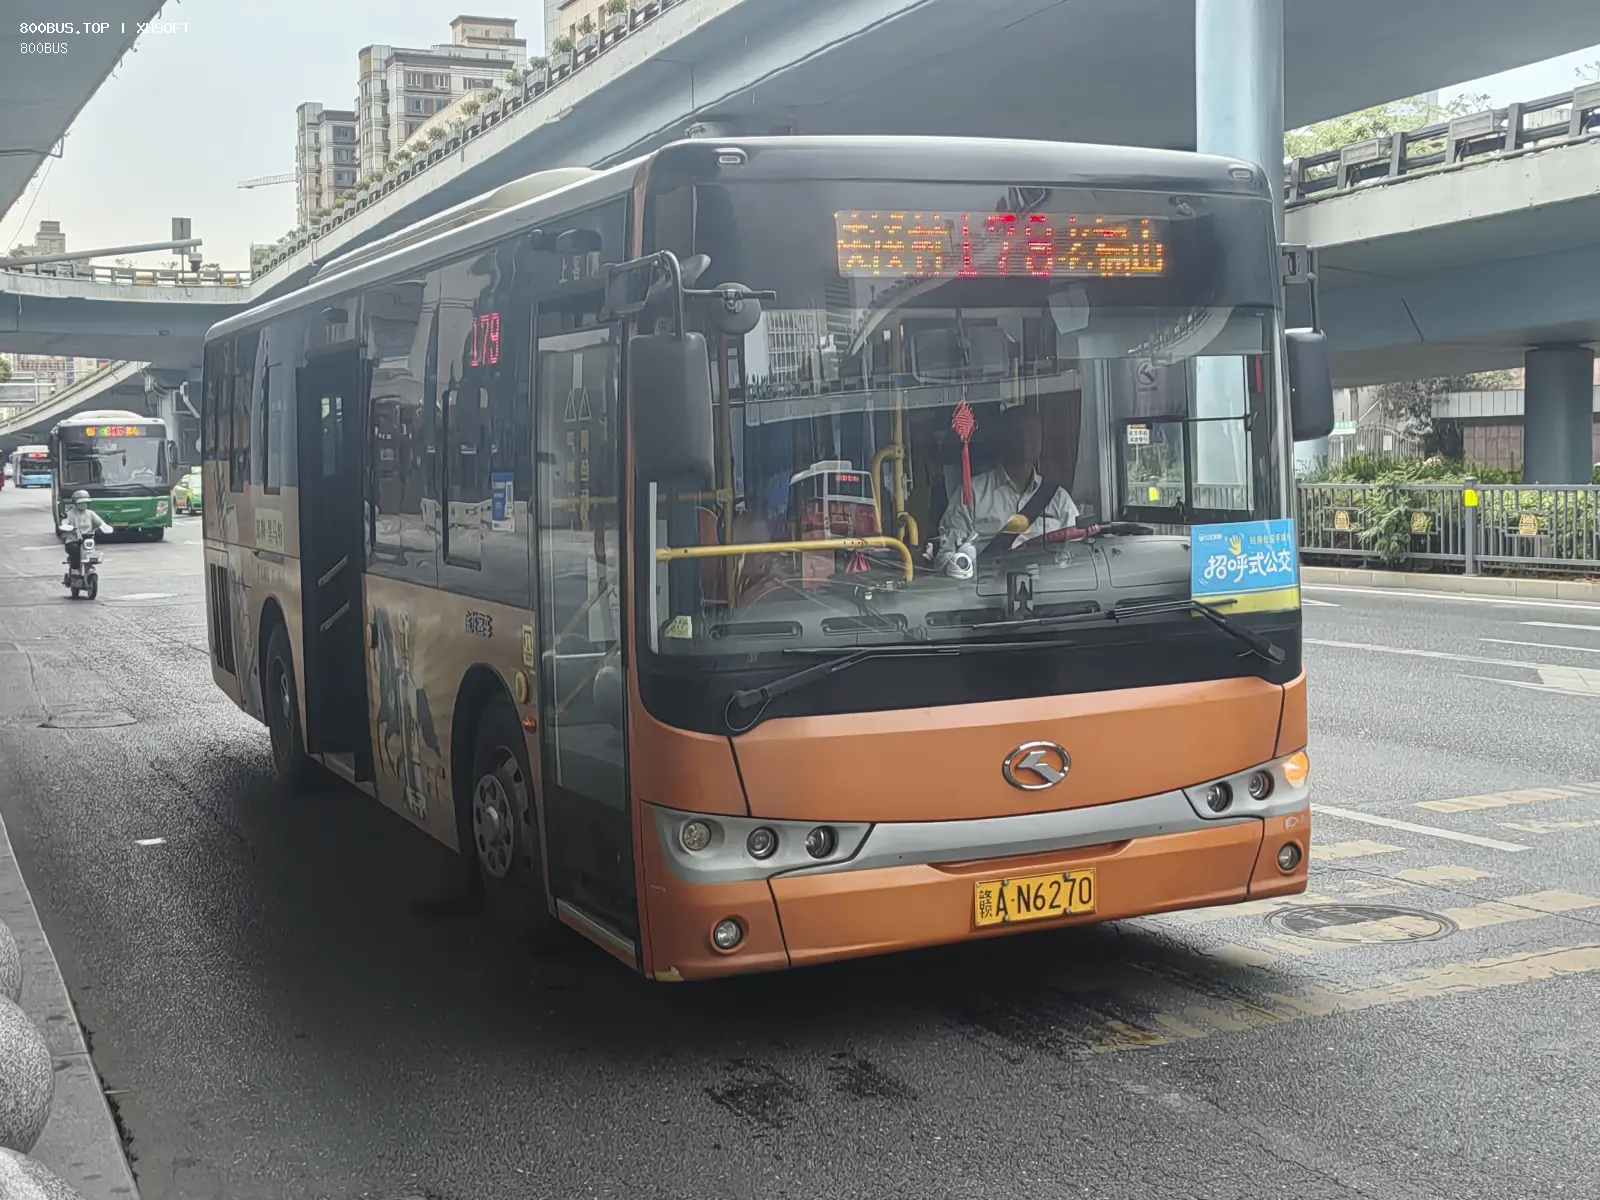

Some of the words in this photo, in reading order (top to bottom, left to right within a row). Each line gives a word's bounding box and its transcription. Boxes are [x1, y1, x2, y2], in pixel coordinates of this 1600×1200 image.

[471, 312, 500, 367] 179
[1204, 550, 1293, 584] 招呼式公交
